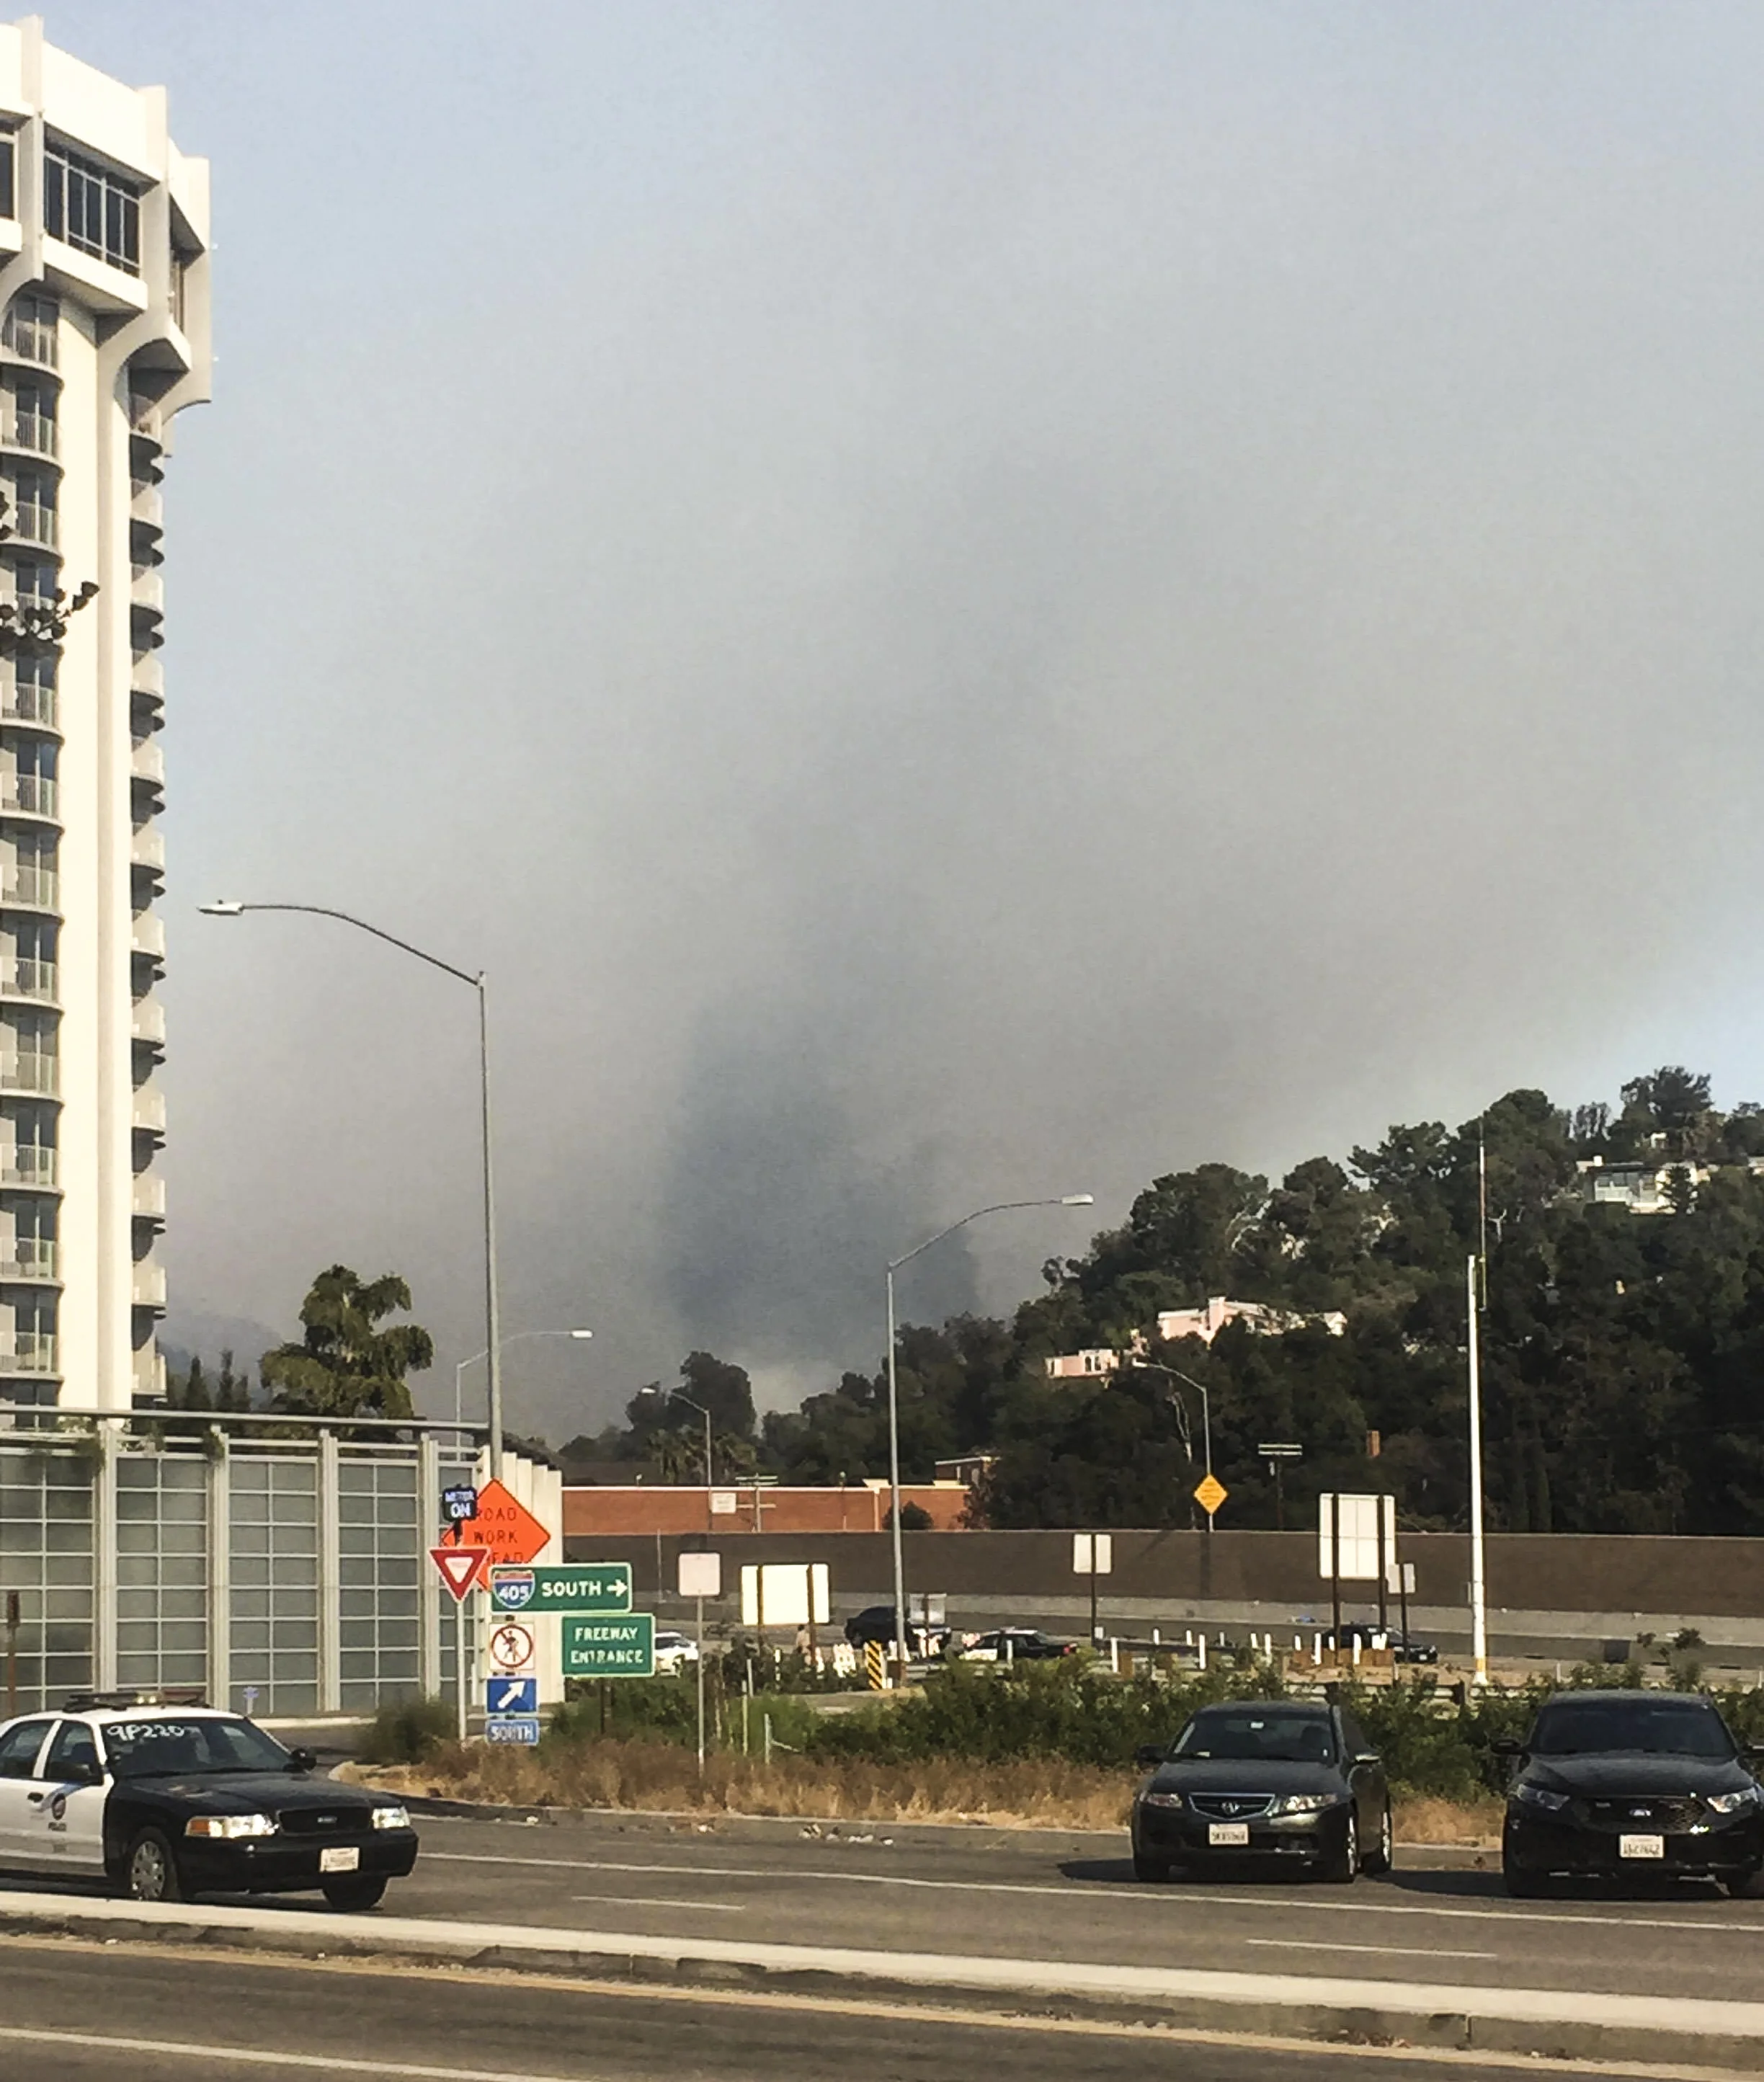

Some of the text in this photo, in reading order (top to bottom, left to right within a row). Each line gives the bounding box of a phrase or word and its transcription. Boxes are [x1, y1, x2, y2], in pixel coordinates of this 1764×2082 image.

[450, 1503, 471, 1518] ON
[473, 1529, 518, 1544] WORK
[499, 1580, 602, 1601] 405 SOUTH
[575, 1627, 638, 1642] FREEWAY
[571, 1649, 643, 1664] ENTRANCE
[107, 1724, 185, 1741] 9P220
[491, 1725, 534, 1741] SOUTH
